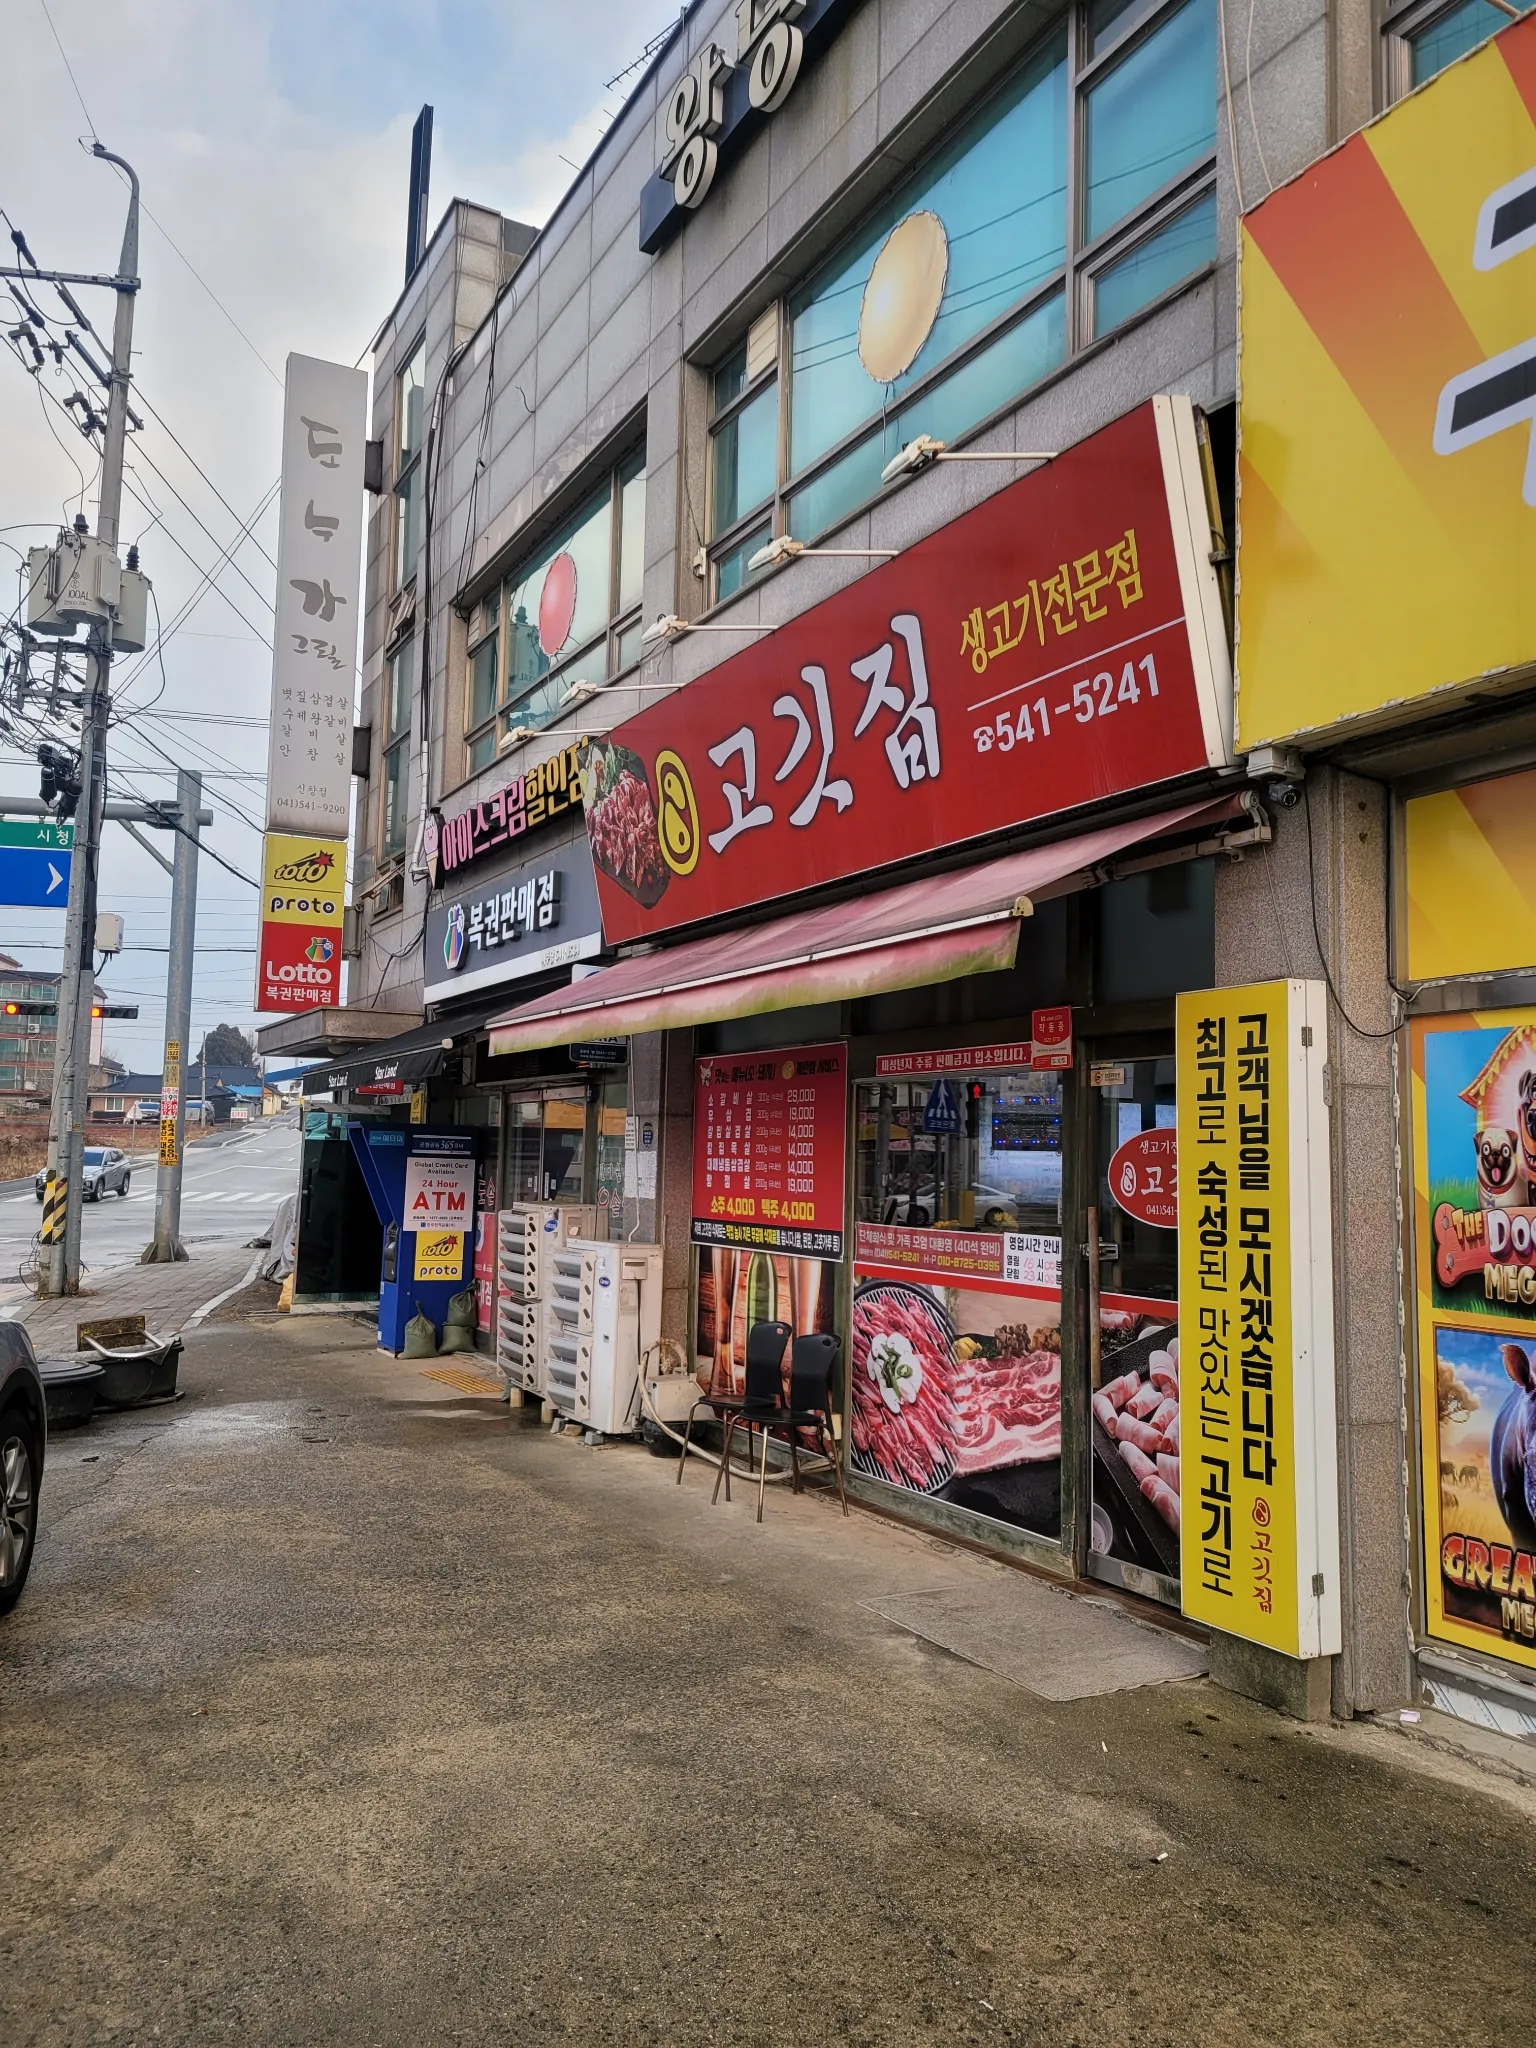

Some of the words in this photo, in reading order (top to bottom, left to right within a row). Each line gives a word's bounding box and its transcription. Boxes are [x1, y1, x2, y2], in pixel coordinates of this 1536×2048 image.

[960, 528, 1143, 673] 생고기전문점
[290, 634, 347, 670] 그릴
[996, 653, 1159, 751] 541-5241
[708, 614, 941, 853] 고깃집
[37, 829, 69, 845] 시청
[274, 860, 329, 883] toto
[270, 896, 335, 914] proto
[467, 869, 556, 950] 복권판매점
[266, 961, 332, 984] Lotto
[265, 986, 332, 1003] 복권판매점
[881, 1057, 912, 1072] 미성년자
[915, 1056, 933, 1069] 주류
[936, 1052, 971, 1067] 판매금지
[974, 1047, 1027, 1065] 업소입니다.
[1196, 1016, 1228, 1146] 최고로
[787, 1089, 815, 1104] 29,000
[1235, 1013, 1272, 1192] 고객님을
[789, 1106, 814, 1122] 19,000
[788, 1124, 814, 1140] 14,000
[788, 1143, 813, 1158] 14,000
[788, 1161, 813, 1176] 14,000
[422, 1180, 433, 1188] 24
[437, 1180, 459, 1188] Hour
[788, 1179, 813, 1194] 19,000
[412, 1191, 466, 1211] ATM
[711, 1196, 725, 1214] 소주
[727, 1197, 755, 1217] 4,000
[762, 1199, 779, 1218] 맥주
[781, 1201, 815, 1221] 4,000
[1197, 1159, 1229, 1293] 숙성된
[1452, 1208, 1485, 1244] THE
[1486, 1208, 1536, 1260] DO
[859, 1229, 886, 1245] 단체회식
[887, 1232, 895, 1246] 및
[897, 1234, 911, 1248] 가족
[955, 1240, 978, 1255] (40석
[980, 1241, 1000, 1257] 완비)
[1009, 1236, 1041, 1253] 영업시간
[1043, 1239, 1060, 1254] 안내
[420, 1266, 458, 1277] proto
[1006, 1255, 1020, 1267] 열림
[1037, 1259, 1044, 1270] 시
[1006, 1268, 1020, 1279] 닫힘
[1024, 1270, 1035, 1281] 23
[1037, 1272, 1044, 1283] 시
[1239, 1206, 1278, 1487] 모시겠습니다
[1199, 1306, 1232, 1444] 맛있는
[1200, 1455, 1234, 1598] 고기로
[1250, 1530, 1274, 1615] 고깃집
[1442, 1534, 1536, 1598] GREA
[1501, 1597, 1536, 1638] ME
